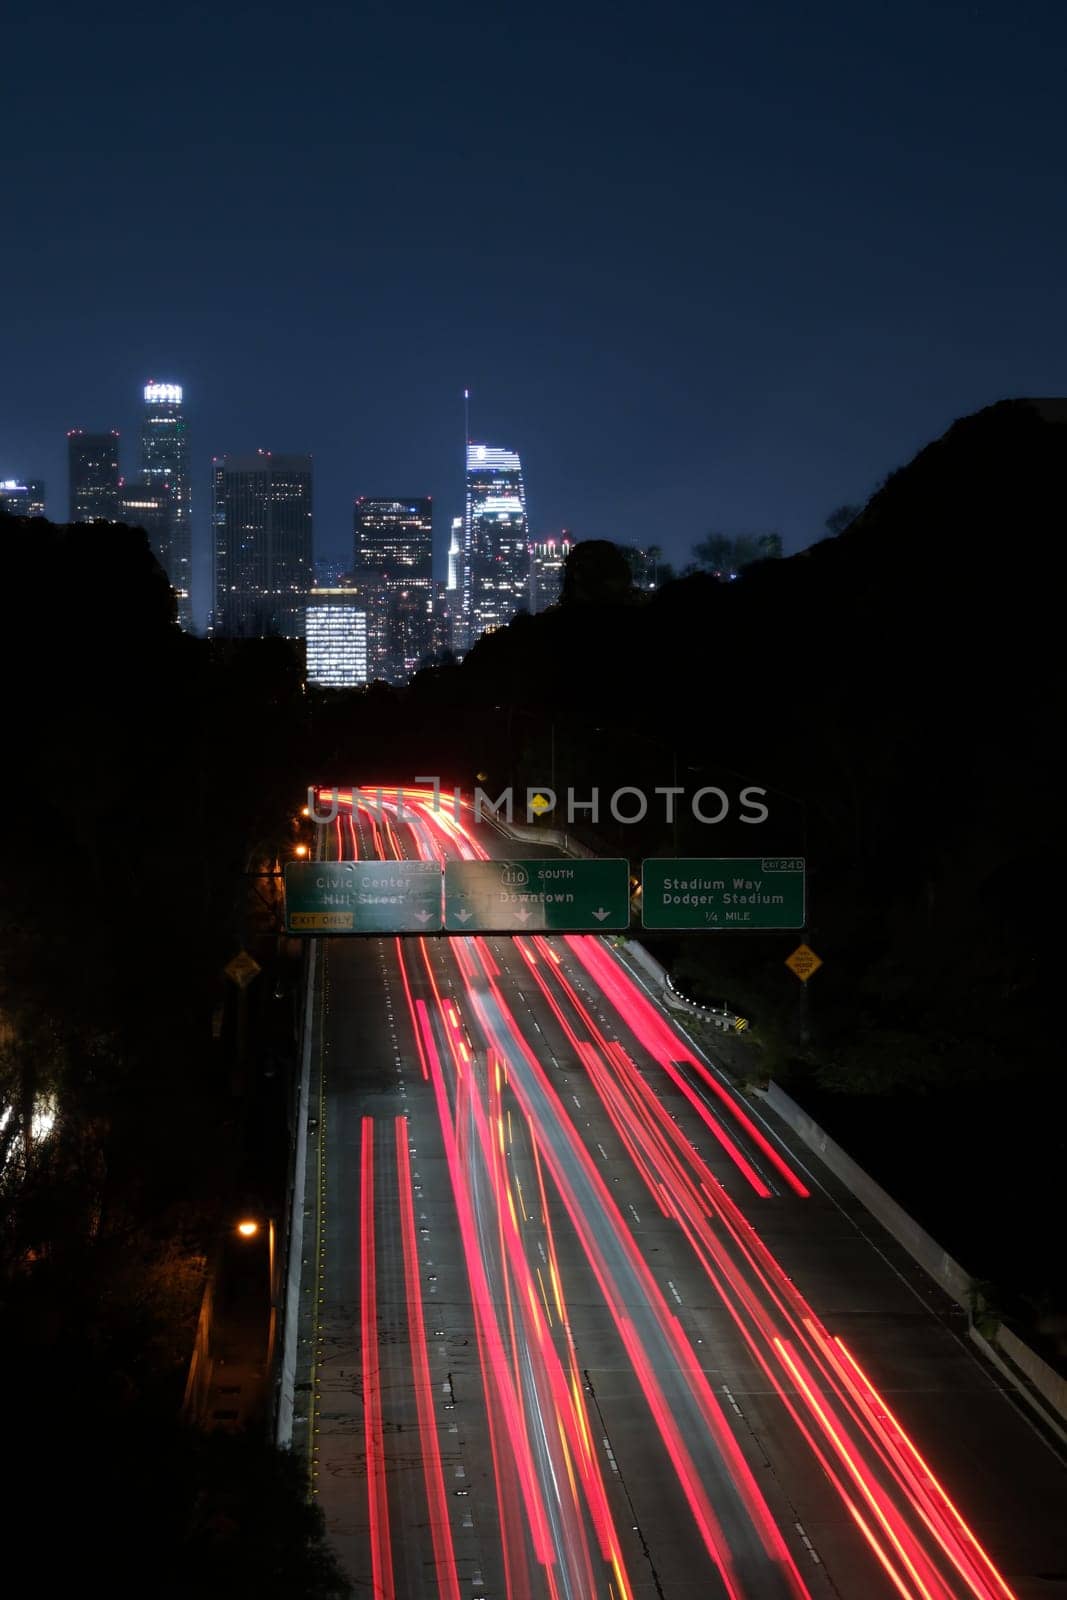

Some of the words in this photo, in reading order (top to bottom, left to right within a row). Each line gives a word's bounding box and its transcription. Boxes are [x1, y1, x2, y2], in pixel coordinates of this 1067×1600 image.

[506, 872, 525, 882] 110
[537, 870, 575, 880] SOUTH
[315, 877, 353, 889] Civic
[361, 877, 412, 888] Center
[663, 878, 725, 890] Stadium
[732, 878, 762, 891] Way
[323, 894, 350, 905] Hill
[358, 894, 406, 905] Street
[500, 892, 575, 903] Downtown
[663, 893, 714, 907] Dodger
[722, 893, 784, 905] Stadium
[292, 914, 316, 925] EXIT
[321, 913, 351, 925] ONLY
[725, 911, 751, 921] MILE
